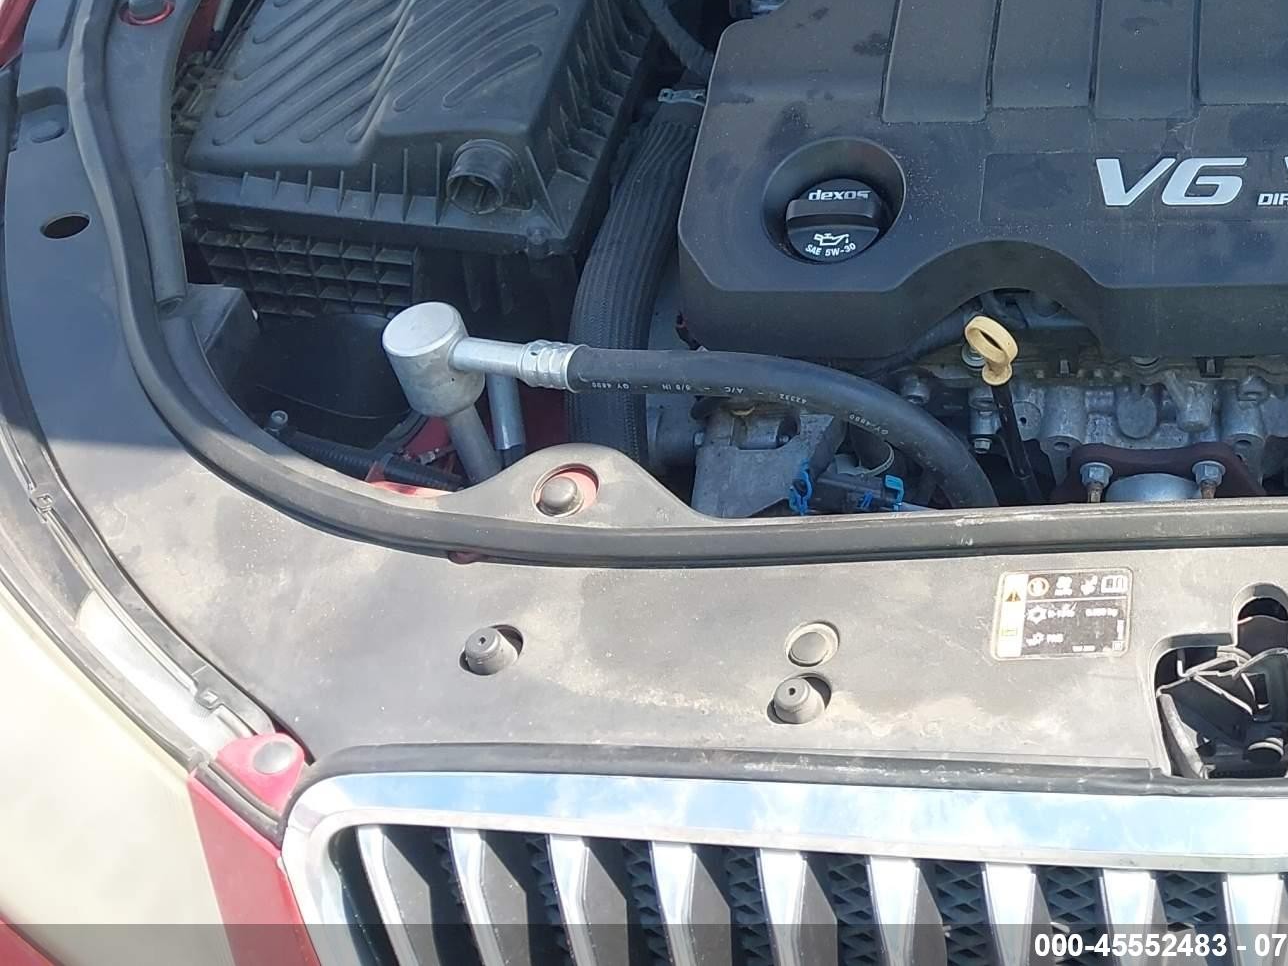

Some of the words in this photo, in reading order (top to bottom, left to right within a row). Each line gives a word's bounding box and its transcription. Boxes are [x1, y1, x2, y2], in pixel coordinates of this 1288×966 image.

[1095, 157, 1248, 206] V6
[808, 189, 872, 201] dexos
[805, 244, 822, 256] SAE
[824, 242, 856, 257] 5W-30
[725, 386, 744, 394] A/C
